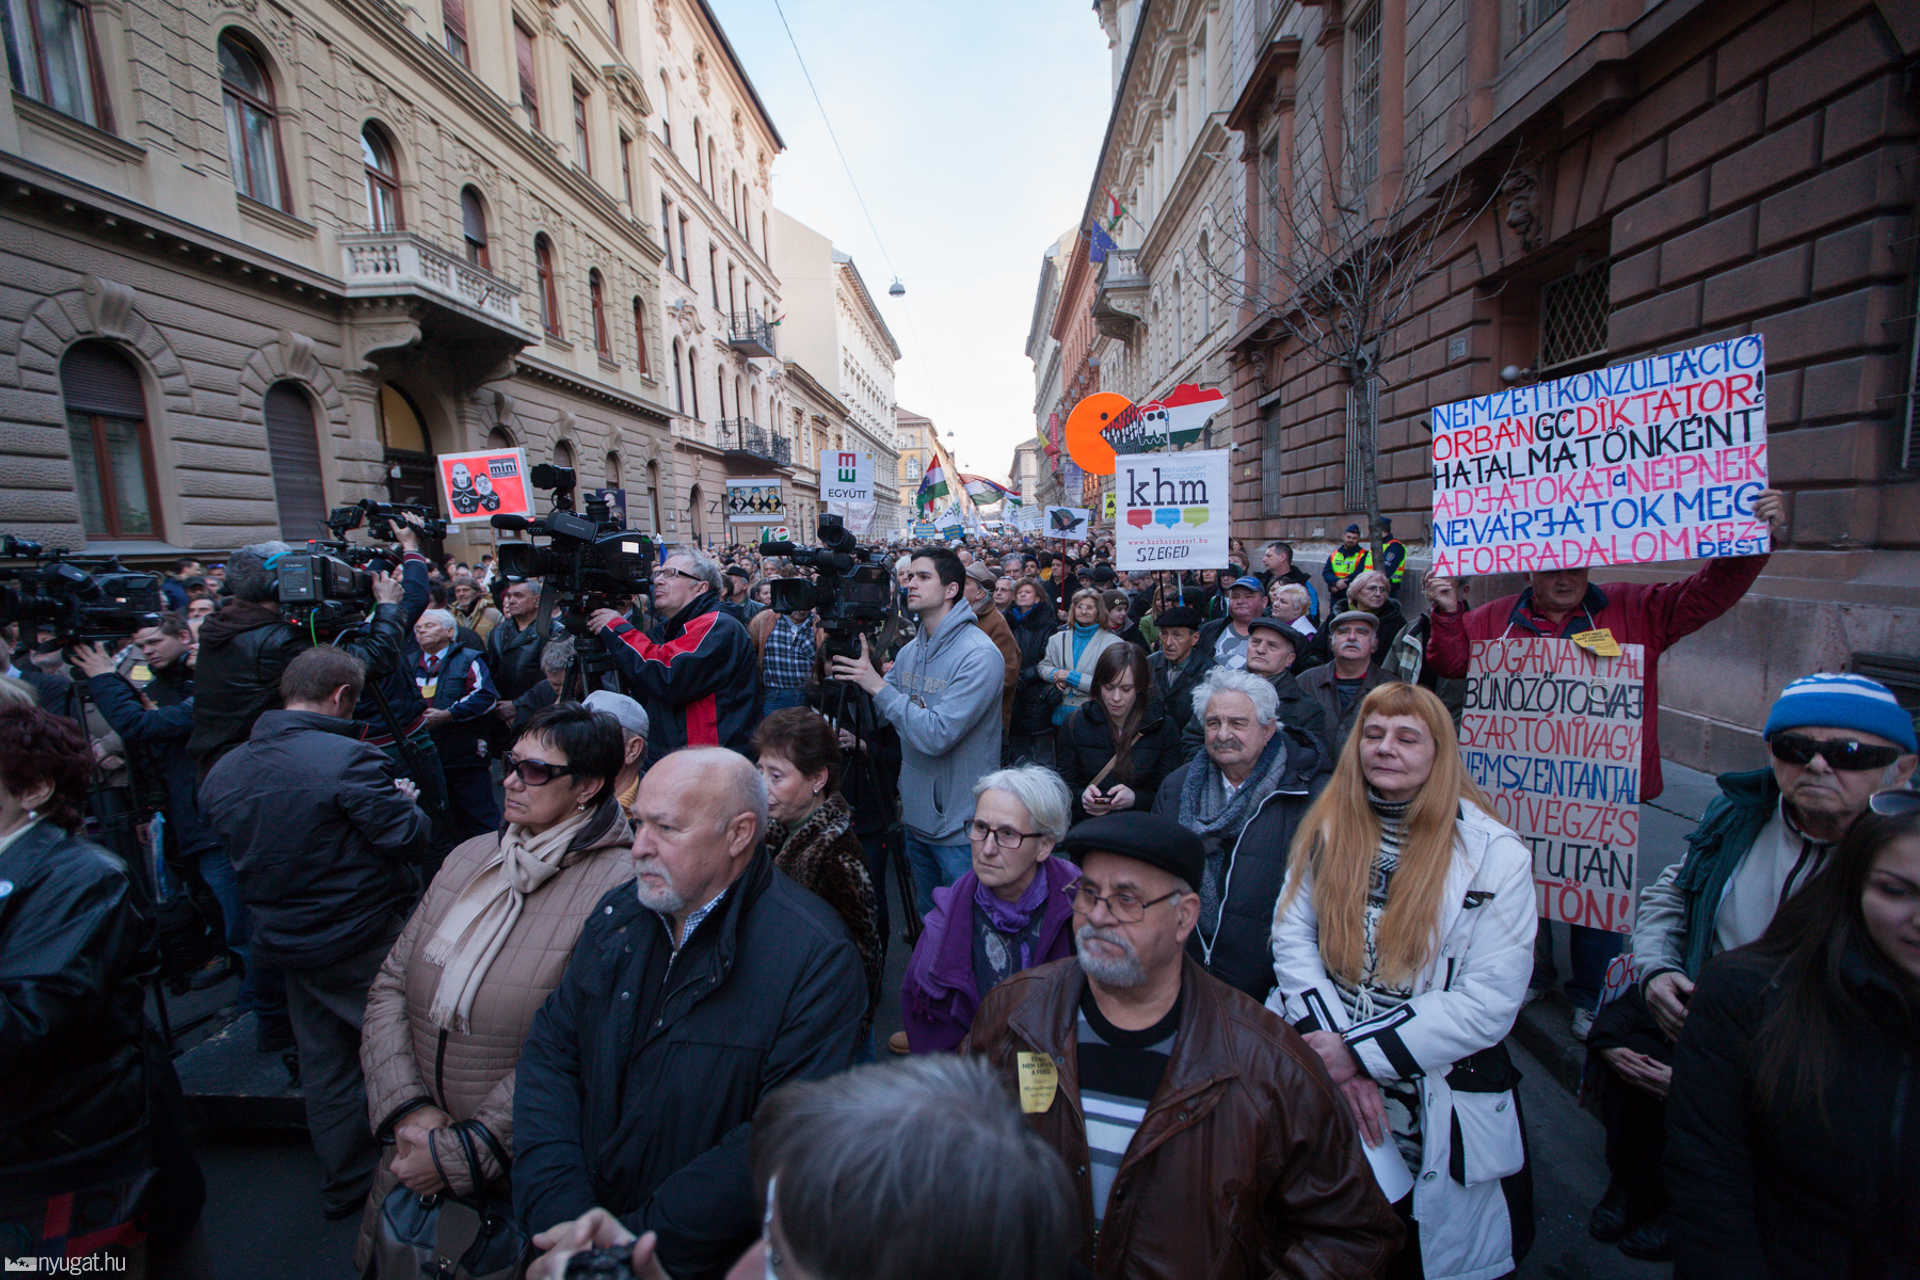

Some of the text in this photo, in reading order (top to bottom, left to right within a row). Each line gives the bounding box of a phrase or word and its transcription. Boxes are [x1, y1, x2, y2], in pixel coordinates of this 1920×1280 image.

[828, 488, 867, 500] EGYÜTT
[1126, 467, 1209, 507] khm
[1136, 545, 1190, 562] SZEGED
